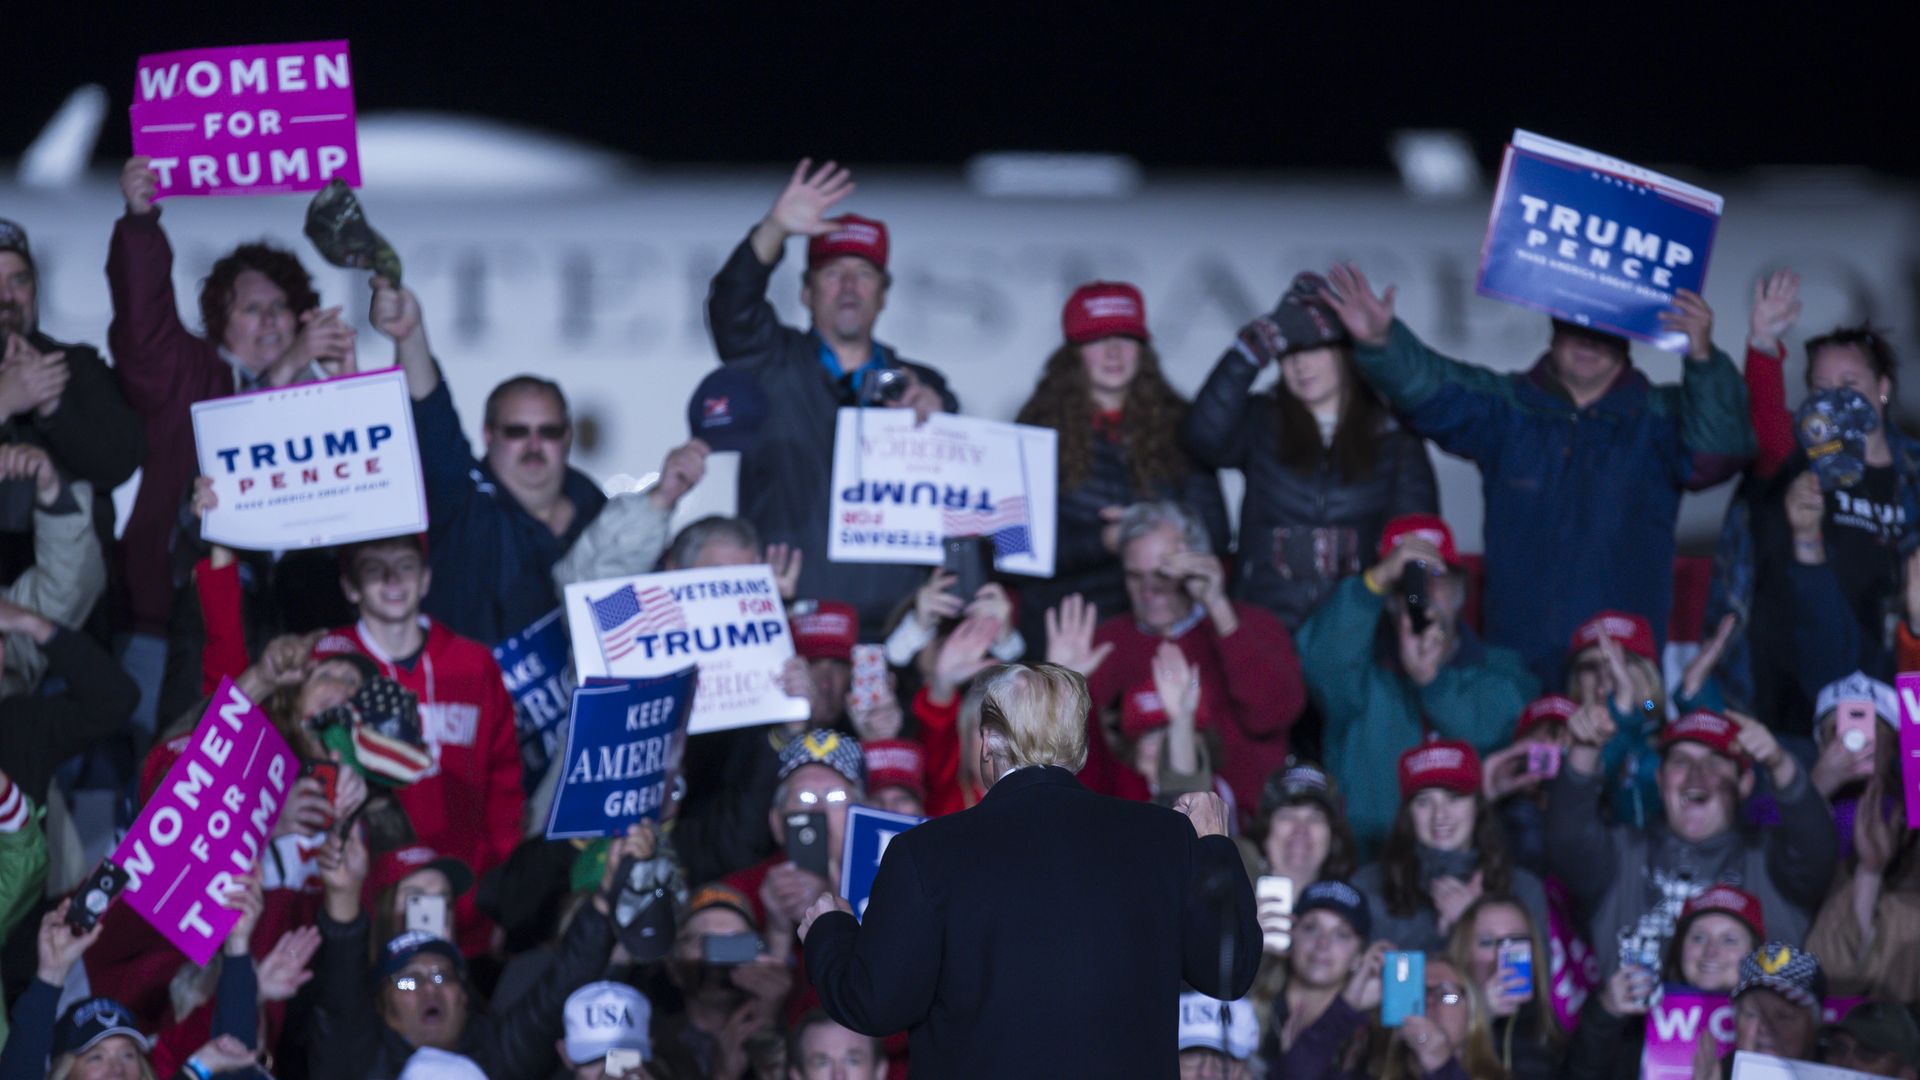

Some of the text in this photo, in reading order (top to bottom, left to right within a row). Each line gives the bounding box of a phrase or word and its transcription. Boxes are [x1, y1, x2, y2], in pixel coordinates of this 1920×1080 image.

[139, 53, 350, 102] WOMEN
[203, 109, 282, 140] FOR
[147, 145, 349, 189] TRUMP
[1518, 194, 1694, 268] TRUMP
[1526, 228, 1674, 288] PENCE
[216, 423, 393, 475] TRUMP
[238, 457, 381, 495] PENCE
[841, 480, 996, 514] TRUMP
[842, 510, 883, 525] FOR
[840, 529, 944, 550] ETERANS
[669, 577, 772, 603] VETERANS
[738, 599, 776, 616] FOR
[635, 619, 784, 660] TRUMP
[625, 695, 676, 732] KEEP
[566, 732, 674, 785] AMERI
[121, 684, 253, 894] WOMEN
[189, 783, 246, 863] FOR
[177, 752, 287, 939] TRUMP
[584, 1003, 635, 1030] USA
